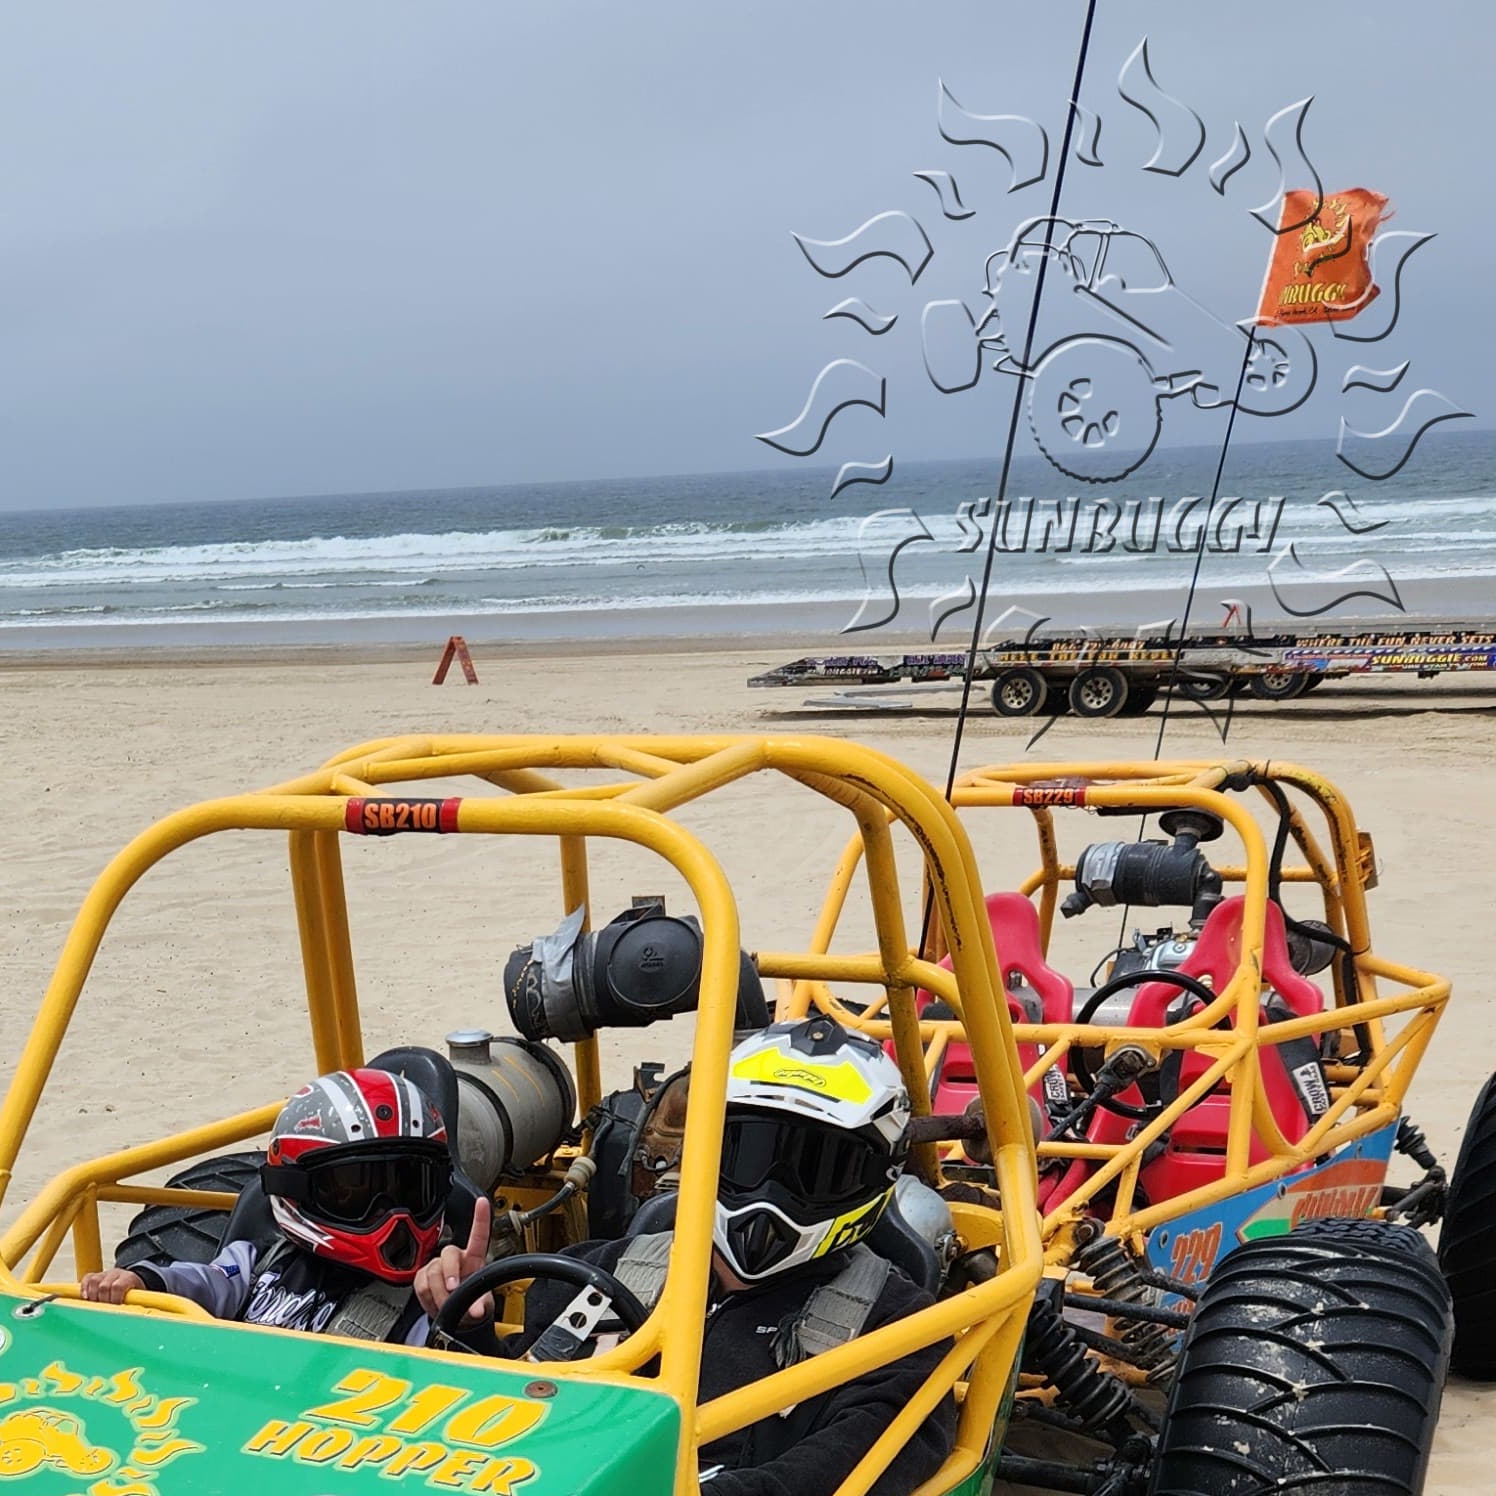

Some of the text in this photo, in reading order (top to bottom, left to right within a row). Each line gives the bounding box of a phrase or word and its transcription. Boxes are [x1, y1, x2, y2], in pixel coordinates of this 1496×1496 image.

[1378, 636, 1406, 646] FUN
[1410, 635, 1457, 646] NEVER
[1460, 635, 1492, 645] SETS
[1023, 788, 1074, 804] SB229
[364, 803, 437, 829] SB210
[303, 1368, 553, 1449] 210
